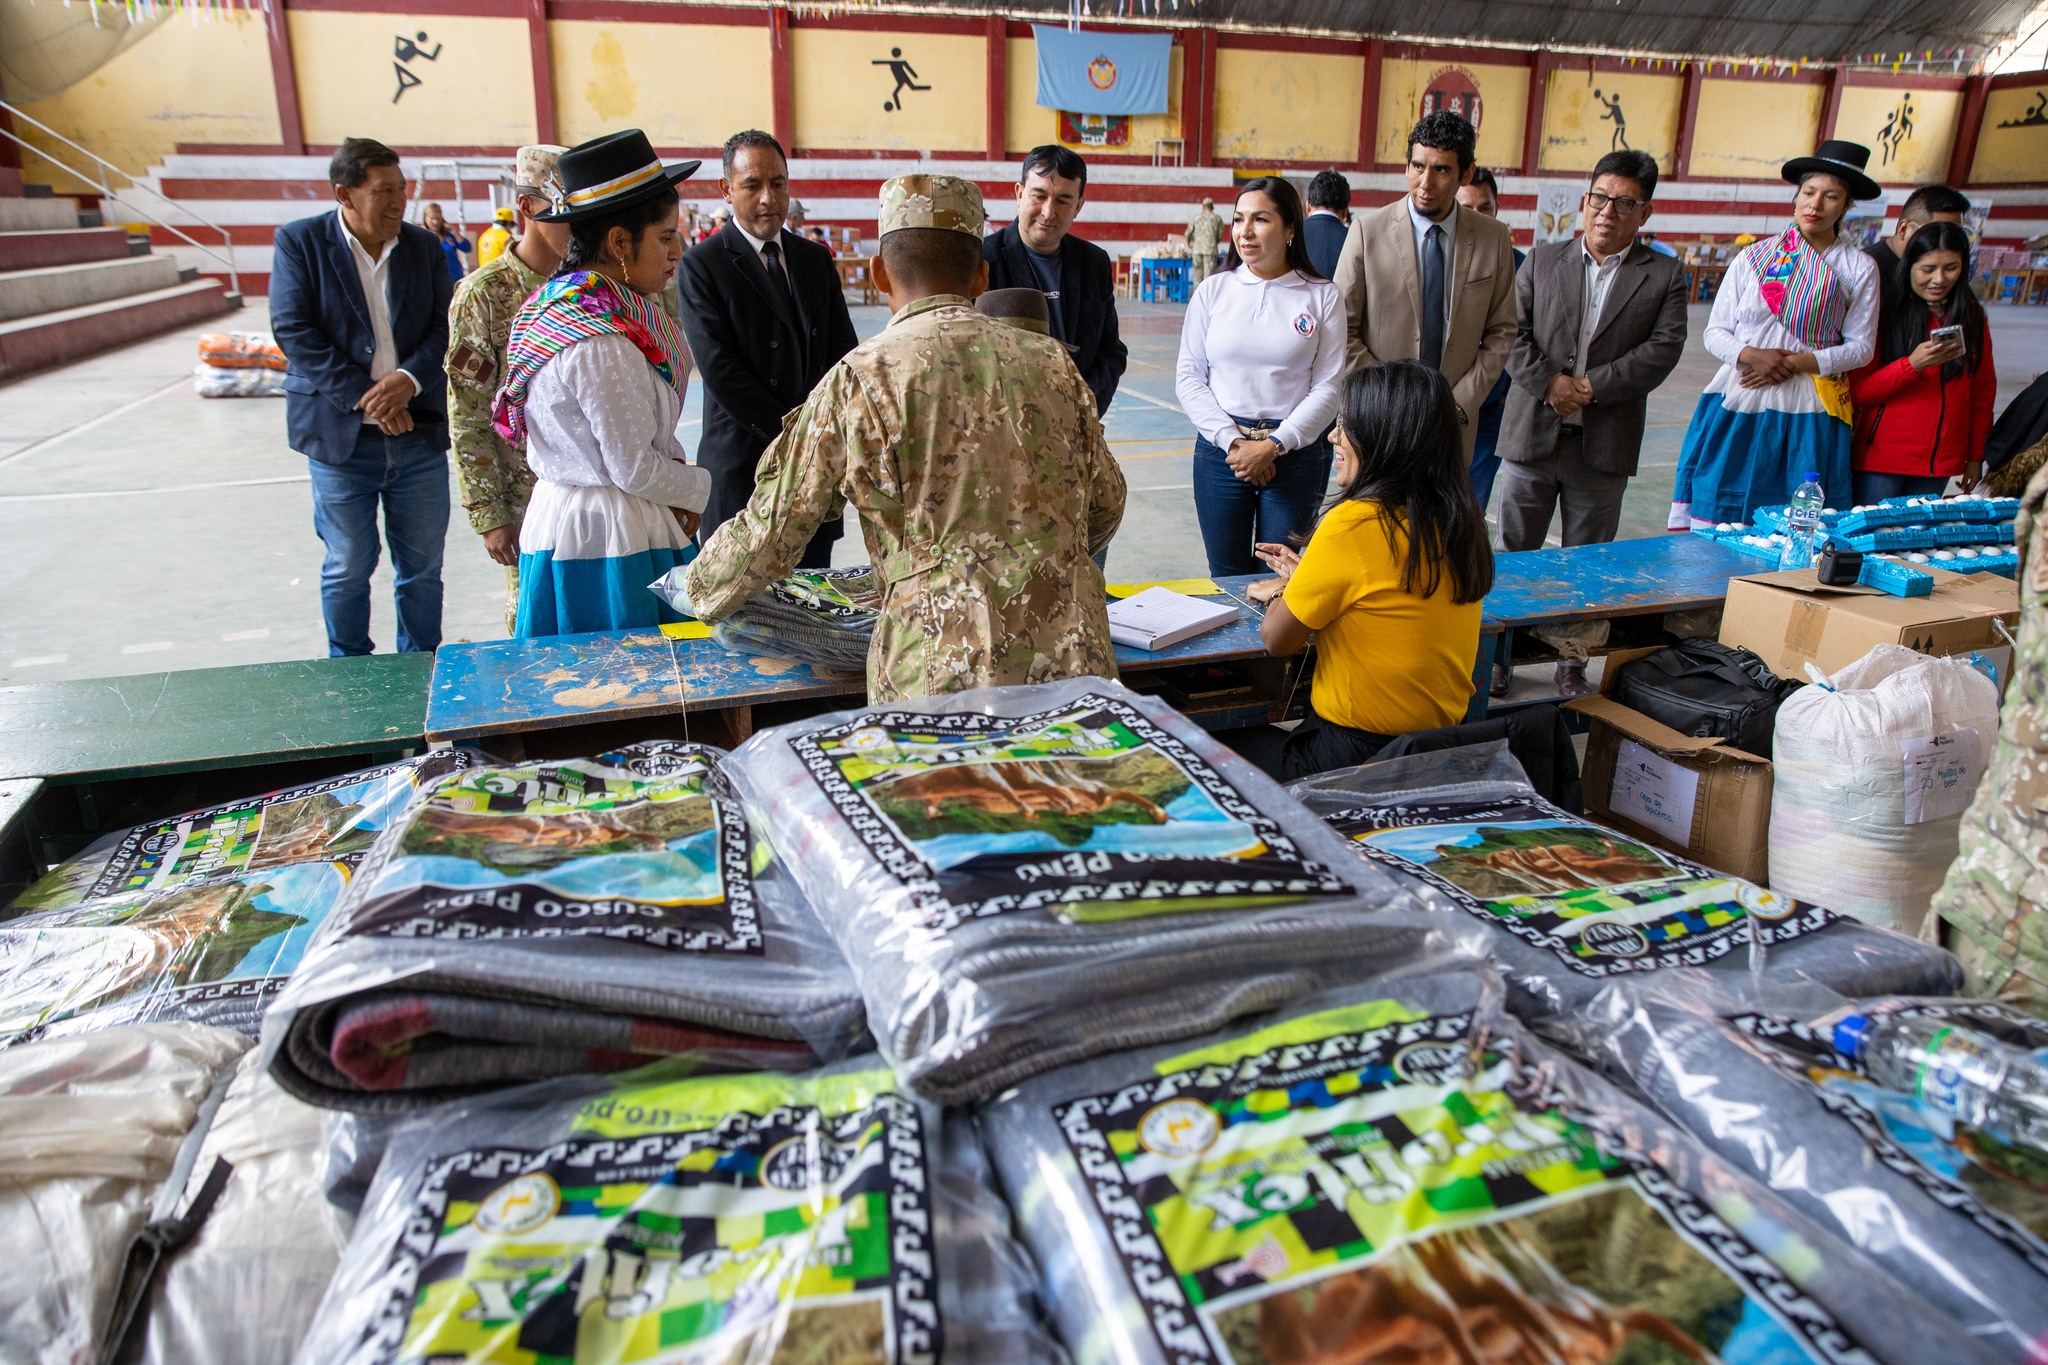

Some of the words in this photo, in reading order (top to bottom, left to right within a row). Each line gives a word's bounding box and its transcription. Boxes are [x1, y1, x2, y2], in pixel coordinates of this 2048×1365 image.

[1795, 509, 1819, 519] CIEL
[183, 818, 239, 885] Profite
[1015, 850, 1113, 884] PERÚ
[533, 899, 665, 919] CUSCO
